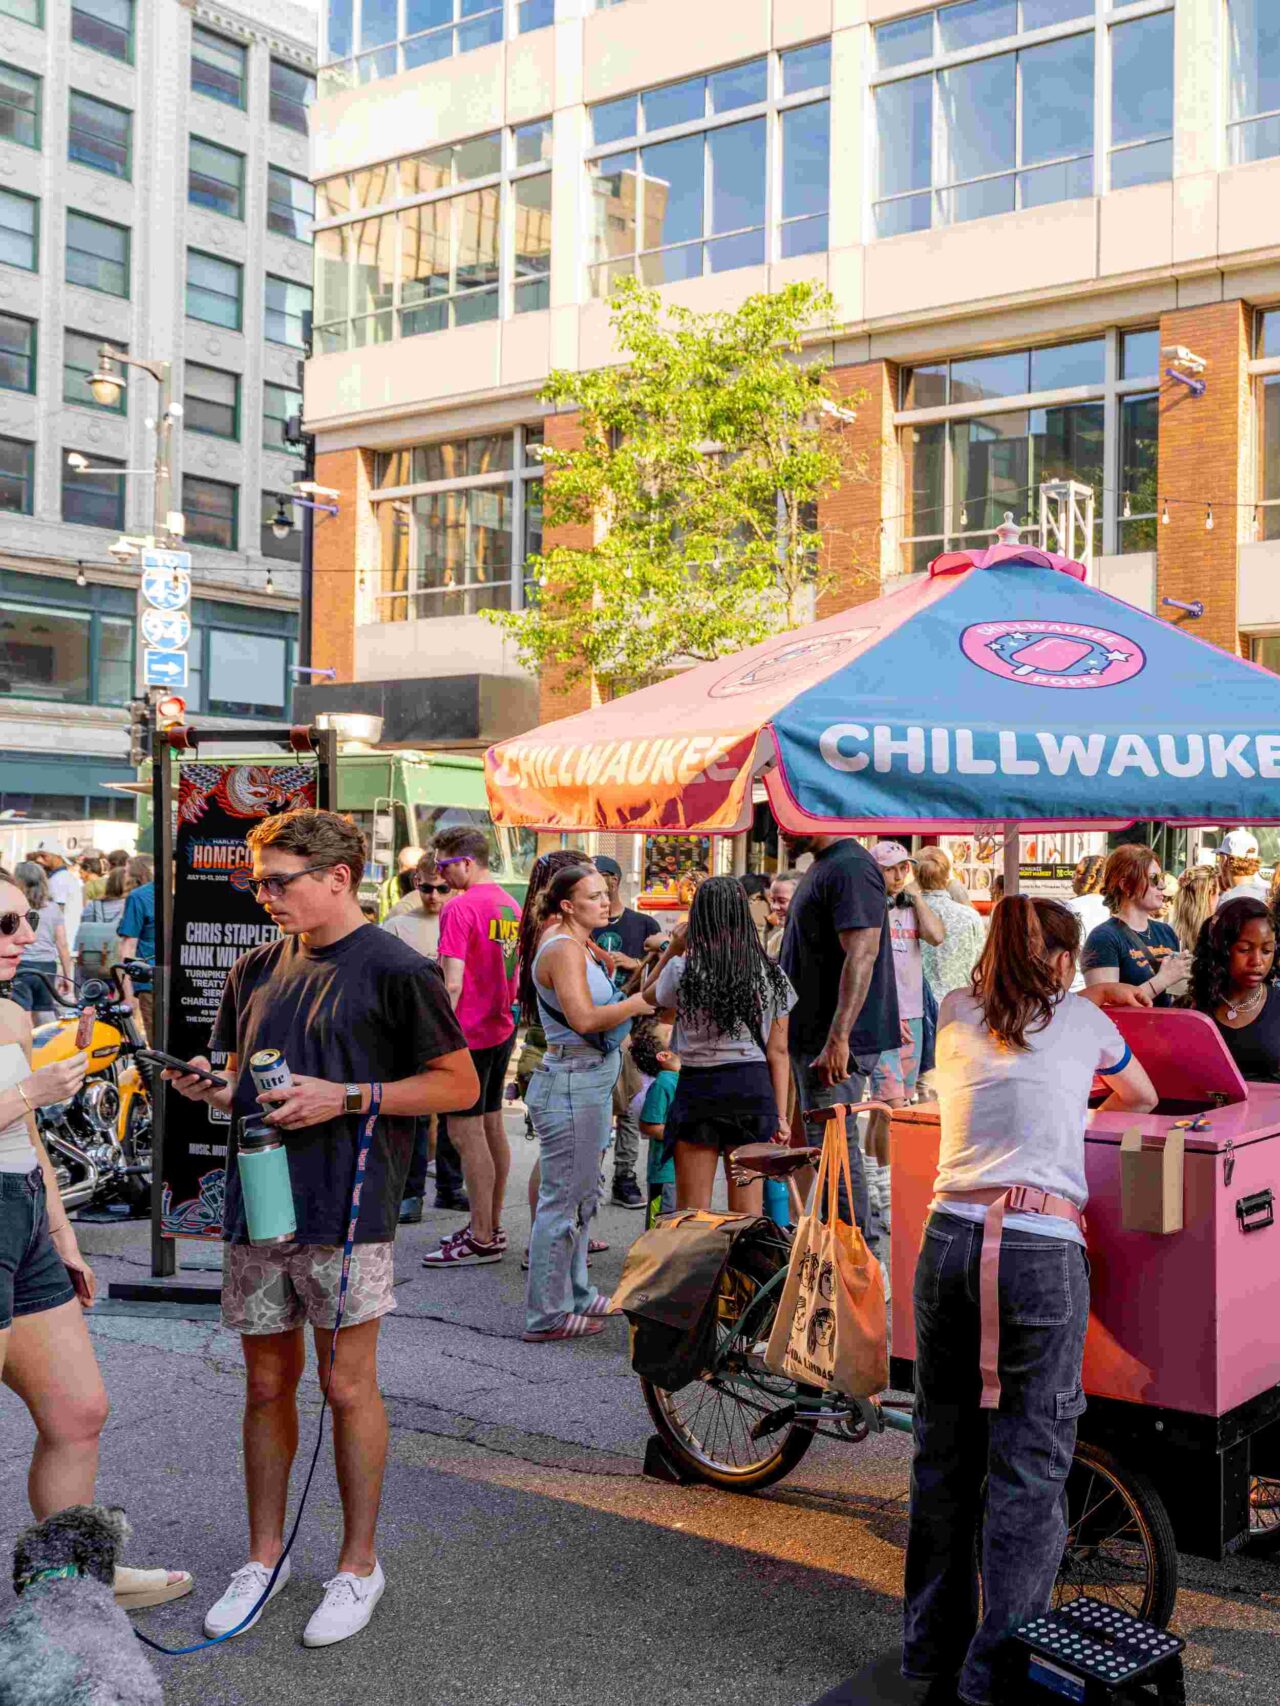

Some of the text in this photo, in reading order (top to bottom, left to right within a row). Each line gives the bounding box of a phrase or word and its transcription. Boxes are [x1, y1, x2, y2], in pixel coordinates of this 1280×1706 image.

[147, 617, 184, 643] 94
[977, 622, 1119, 645] CHILLWAUKEE
[1033, 676, 1097, 687] POPS
[494, 736, 741, 790] CHILLWAUKEE
[193, 845, 254, 869] HOMECO
[186, 922, 222, 944] CHRIS
[180, 945, 250, 968] HANK WILL
[185, 969, 227, 979] TURNPIKE
[192, 979, 225, 988] TREATY
[181, 997, 220, 1007] CHARLES
[211, 1051, 226, 1065] BUY
[259, 1074, 285, 1090] Lite
